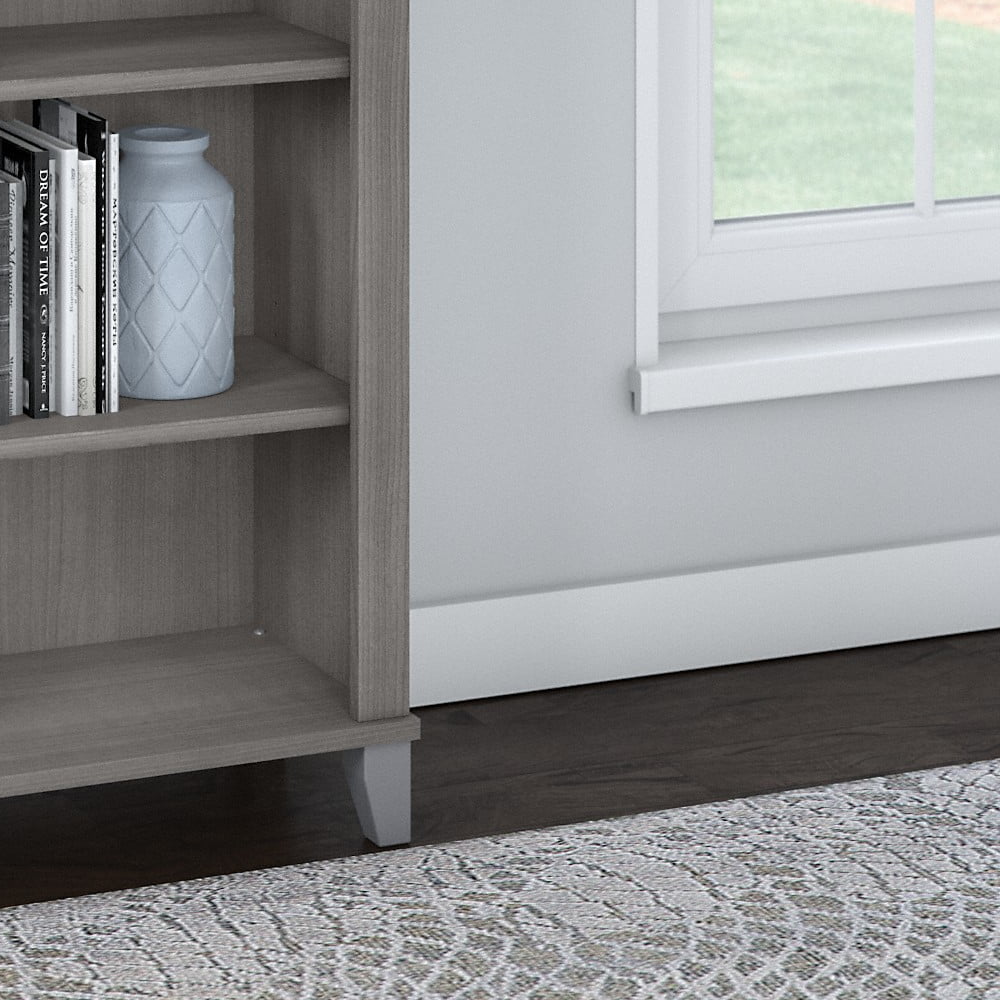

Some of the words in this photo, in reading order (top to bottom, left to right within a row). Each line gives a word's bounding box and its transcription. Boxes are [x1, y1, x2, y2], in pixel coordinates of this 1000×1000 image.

[39, 168, 49, 226] DREAM
[39, 231, 49, 253] OF
[39, 256, 49, 296] TIME
